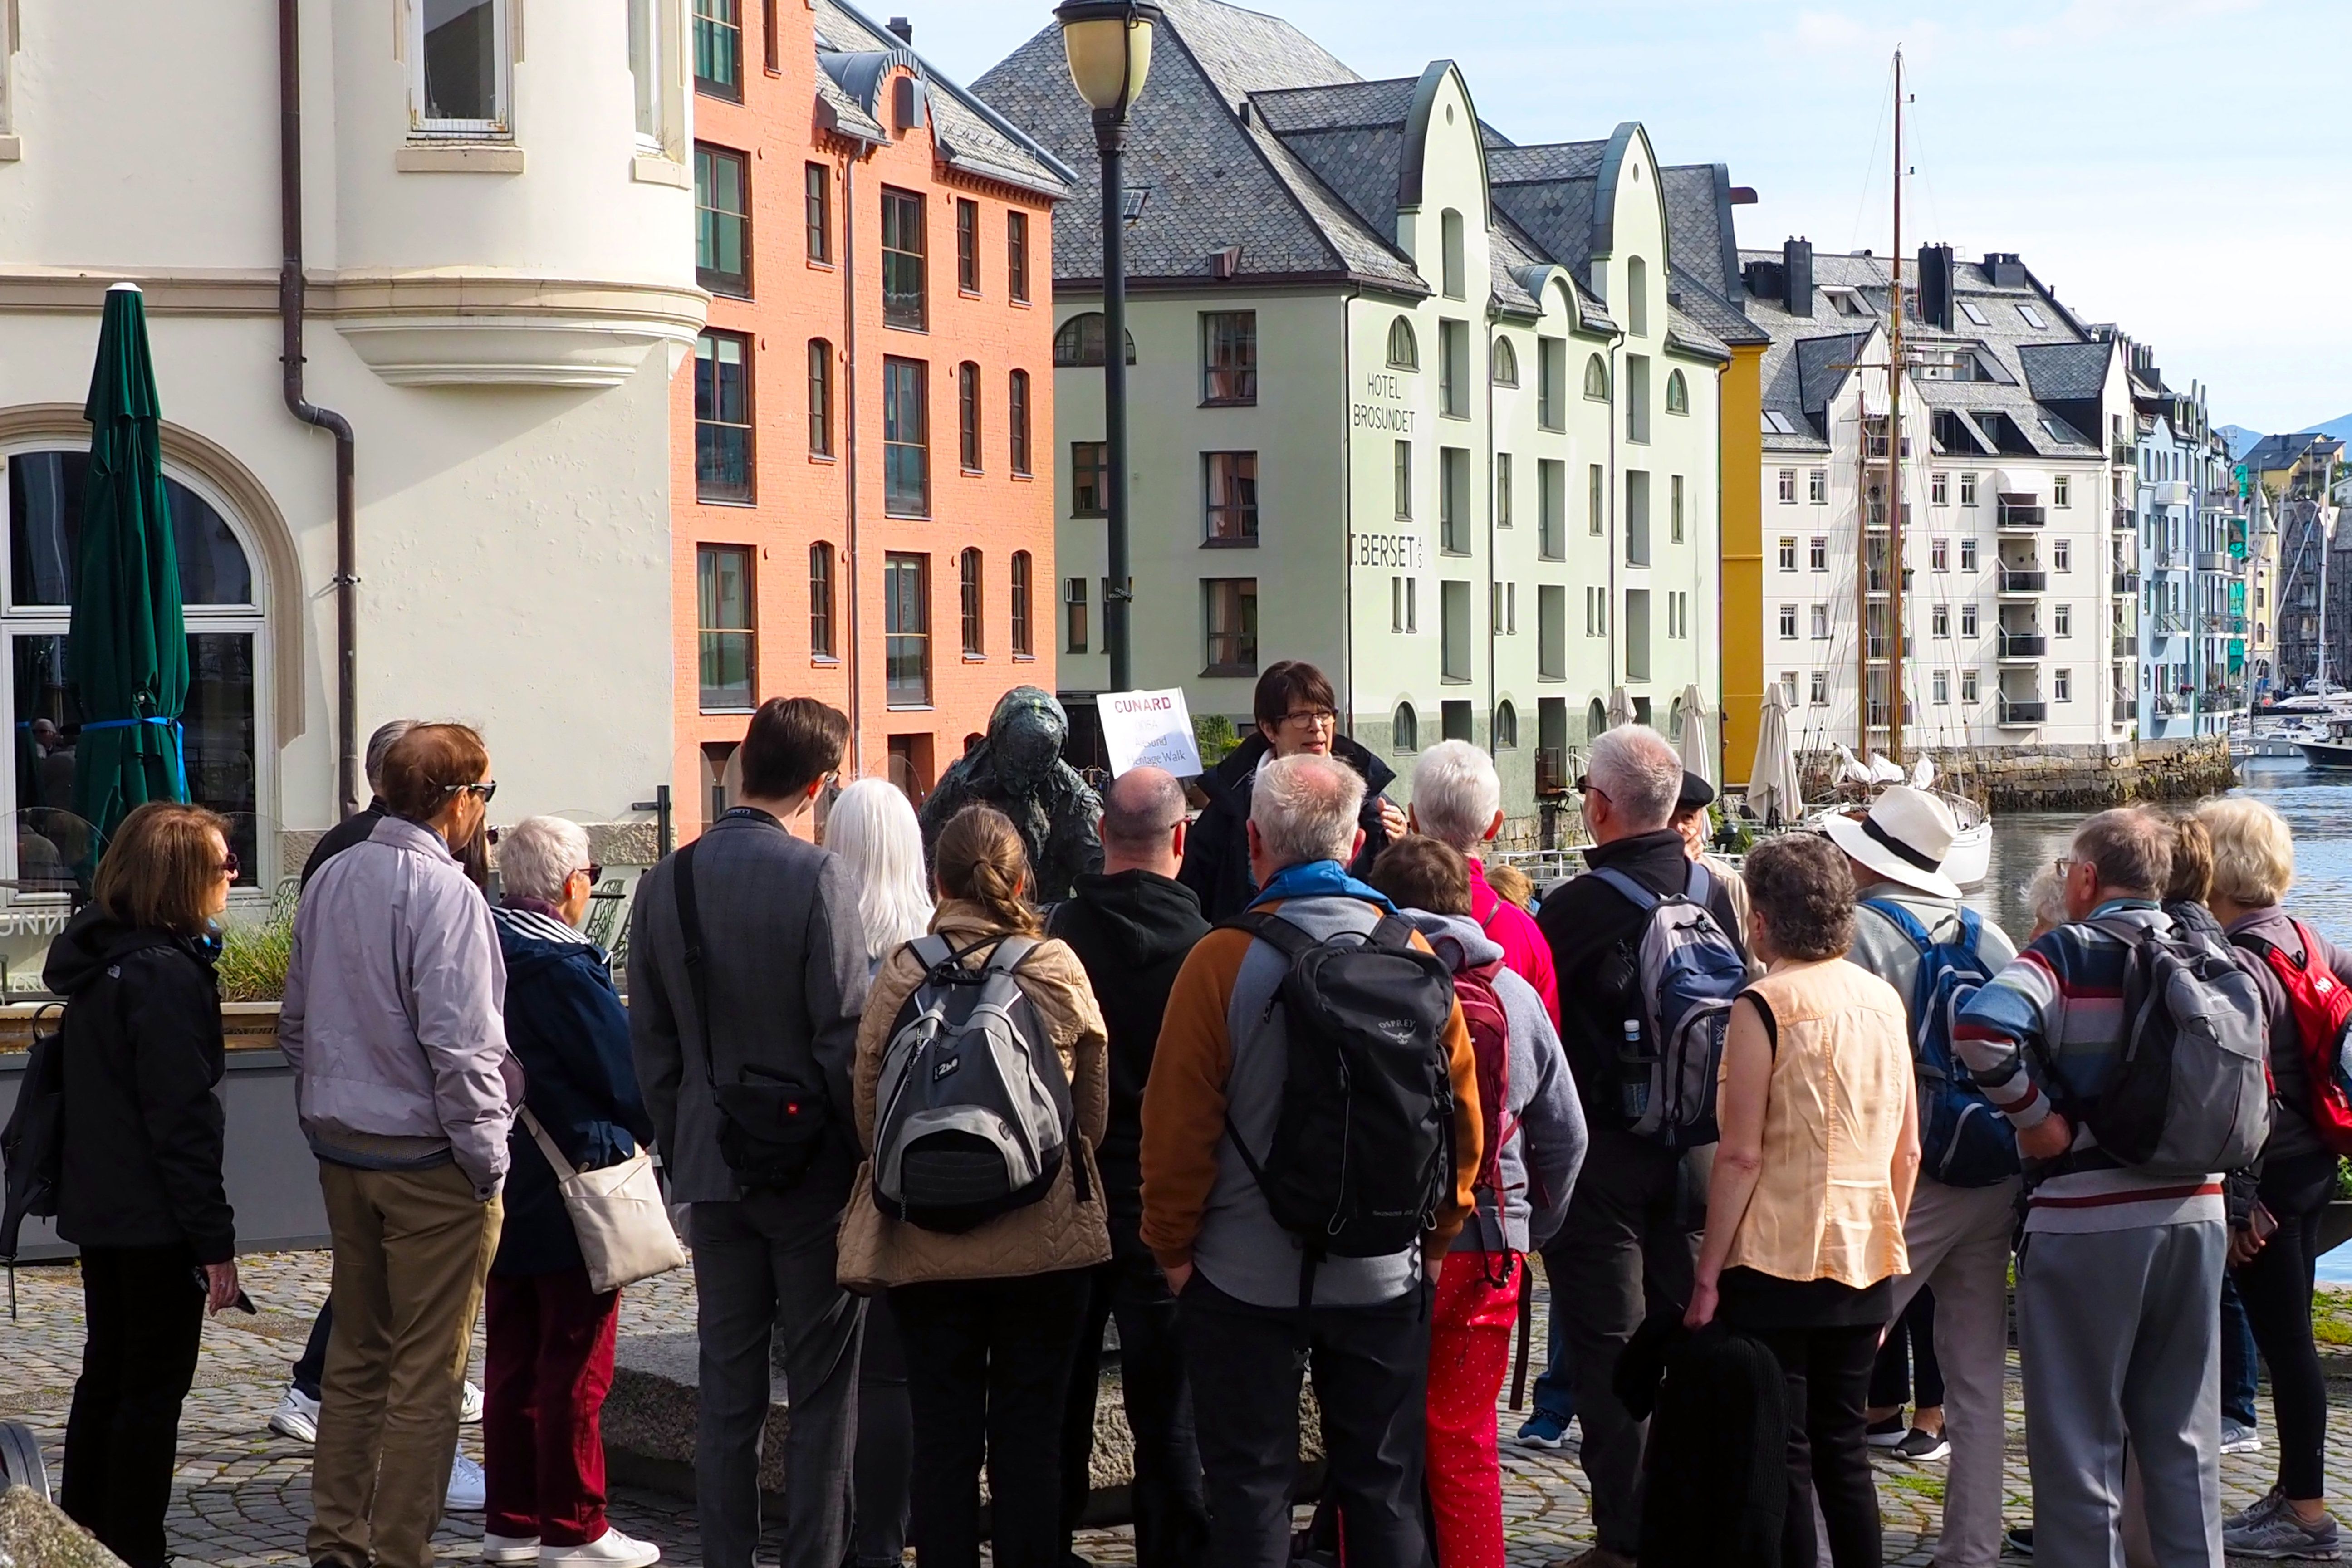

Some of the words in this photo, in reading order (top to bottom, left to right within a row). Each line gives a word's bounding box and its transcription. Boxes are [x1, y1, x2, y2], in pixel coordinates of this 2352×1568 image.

[1367, 372, 1401, 399] HOTEL
[1353, 403, 1415, 433] BROSUNDET
[1115, 697, 1171, 713] CUNARD
[1162, 750, 1186, 762] Walk
[1378, 1019, 1416, 1029] OSPREY
